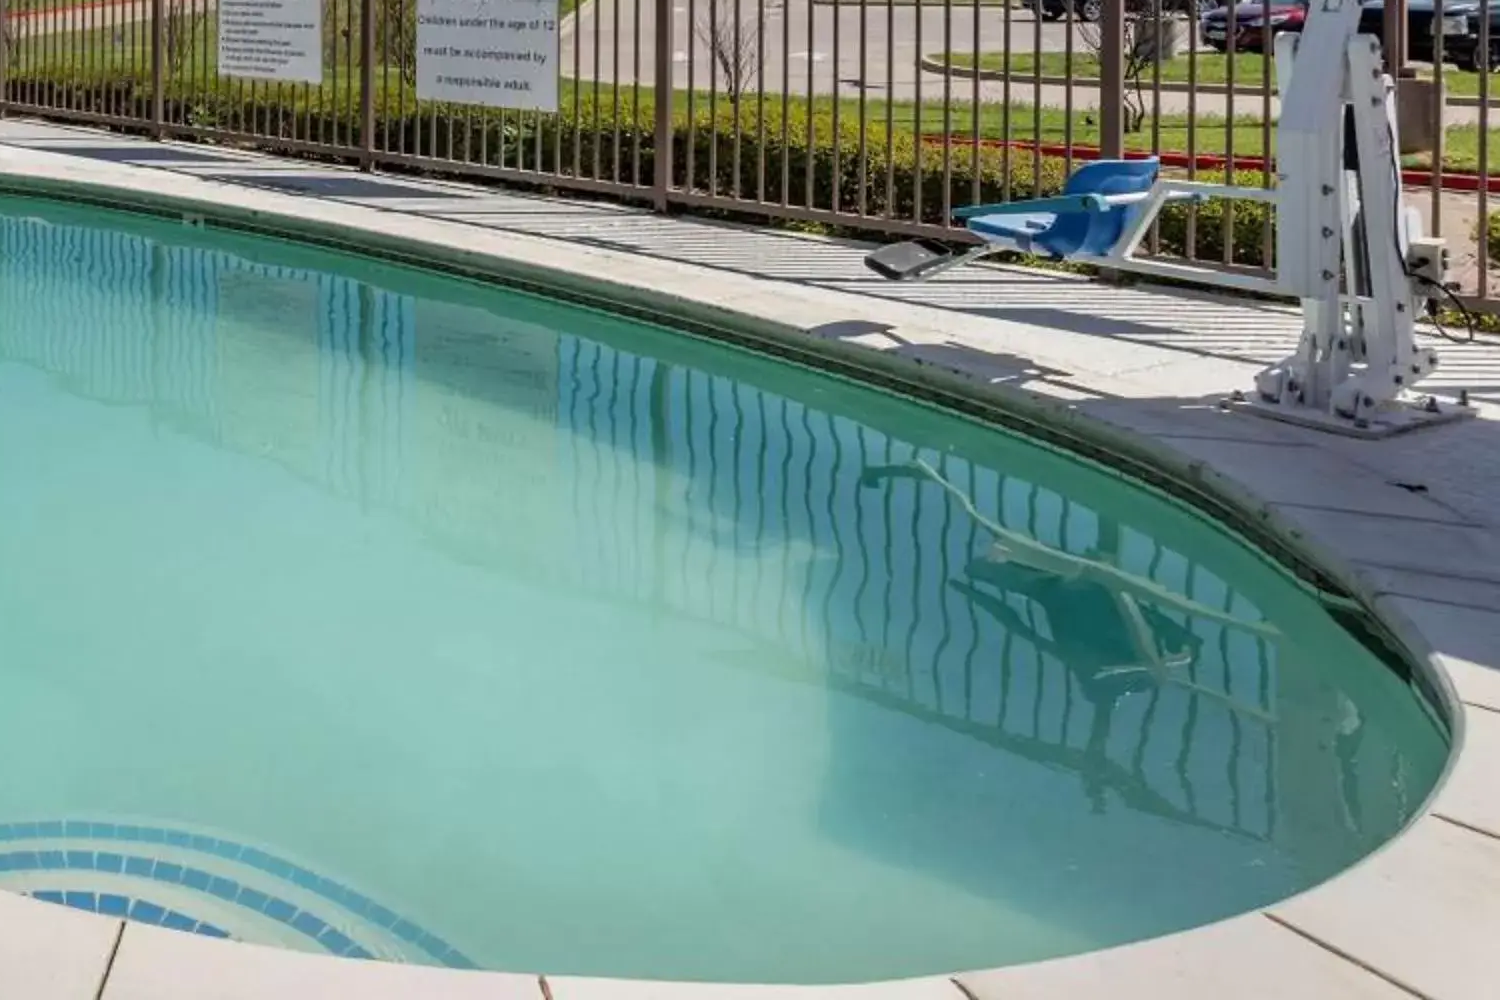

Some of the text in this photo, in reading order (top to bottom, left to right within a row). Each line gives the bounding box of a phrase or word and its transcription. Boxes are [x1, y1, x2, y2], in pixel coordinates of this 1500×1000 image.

[418, 15, 555, 32] Children under the age of 12
[423, 47, 547, 65] must be accompanied by
[443, 76, 501, 88] responsible
